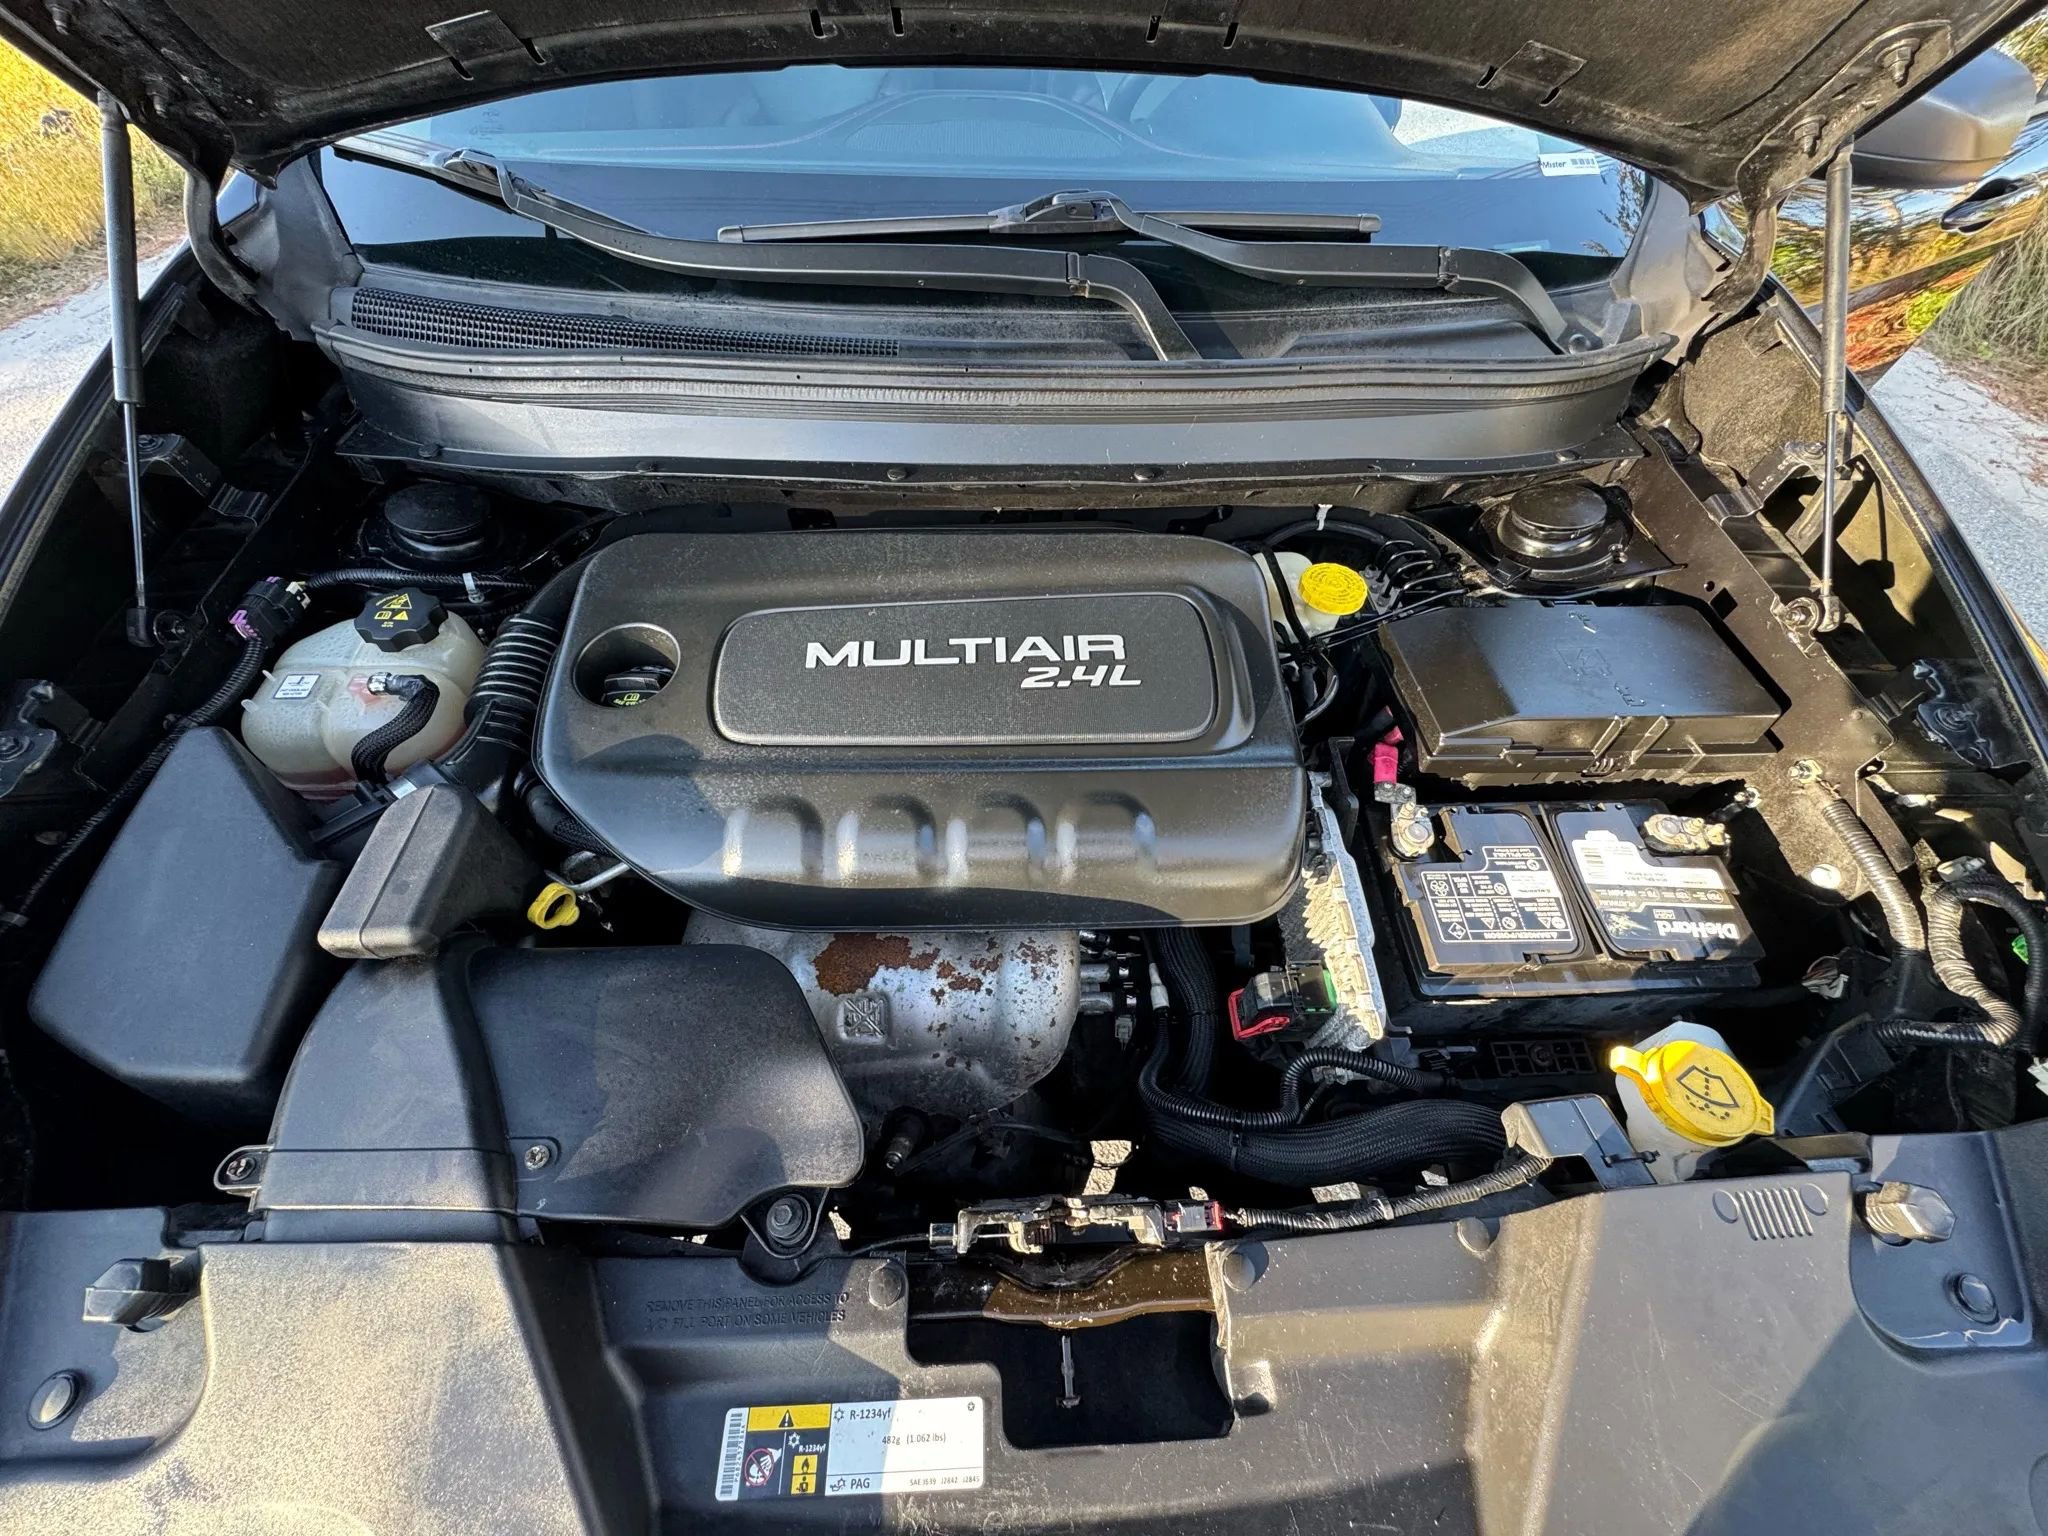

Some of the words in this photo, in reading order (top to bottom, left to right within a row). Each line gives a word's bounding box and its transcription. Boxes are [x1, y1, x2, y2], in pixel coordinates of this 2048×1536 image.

[805, 634, 1126, 669] MULTIAIR
[1020, 664, 1142, 689] 2.4L
[1656, 920, 1740, 939] DieHard
[646, 1300, 694, 1313] REMOVE
[700, 1298, 722, 1310] THIS
[725, 1297, 761, 1310] PANEL
[764, 1296, 785, 1308] FOR
[789, 1293, 831, 1306] ACCESS
[833, 1291, 850, 1304] TO
[674, 1316, 696, 1330] FILL
[701, 1315, 730, 1329] PORT
[735, 1314, 750, 1327] ON
[754, 1311, 788, 1326] SOME
[790, 1309, 846, 1324] VEHICLES
[849, 1407, 892, 1421] R-1234yf
[798, 1443, 826, 1454] R-1234yf
[881, 1434, 901, 1446] 482g
[906, 1433, 931, 1445] (1.062
[932, 1432, 947, 1443] lbs)
[850, 1477, 870, 1490] PAG
